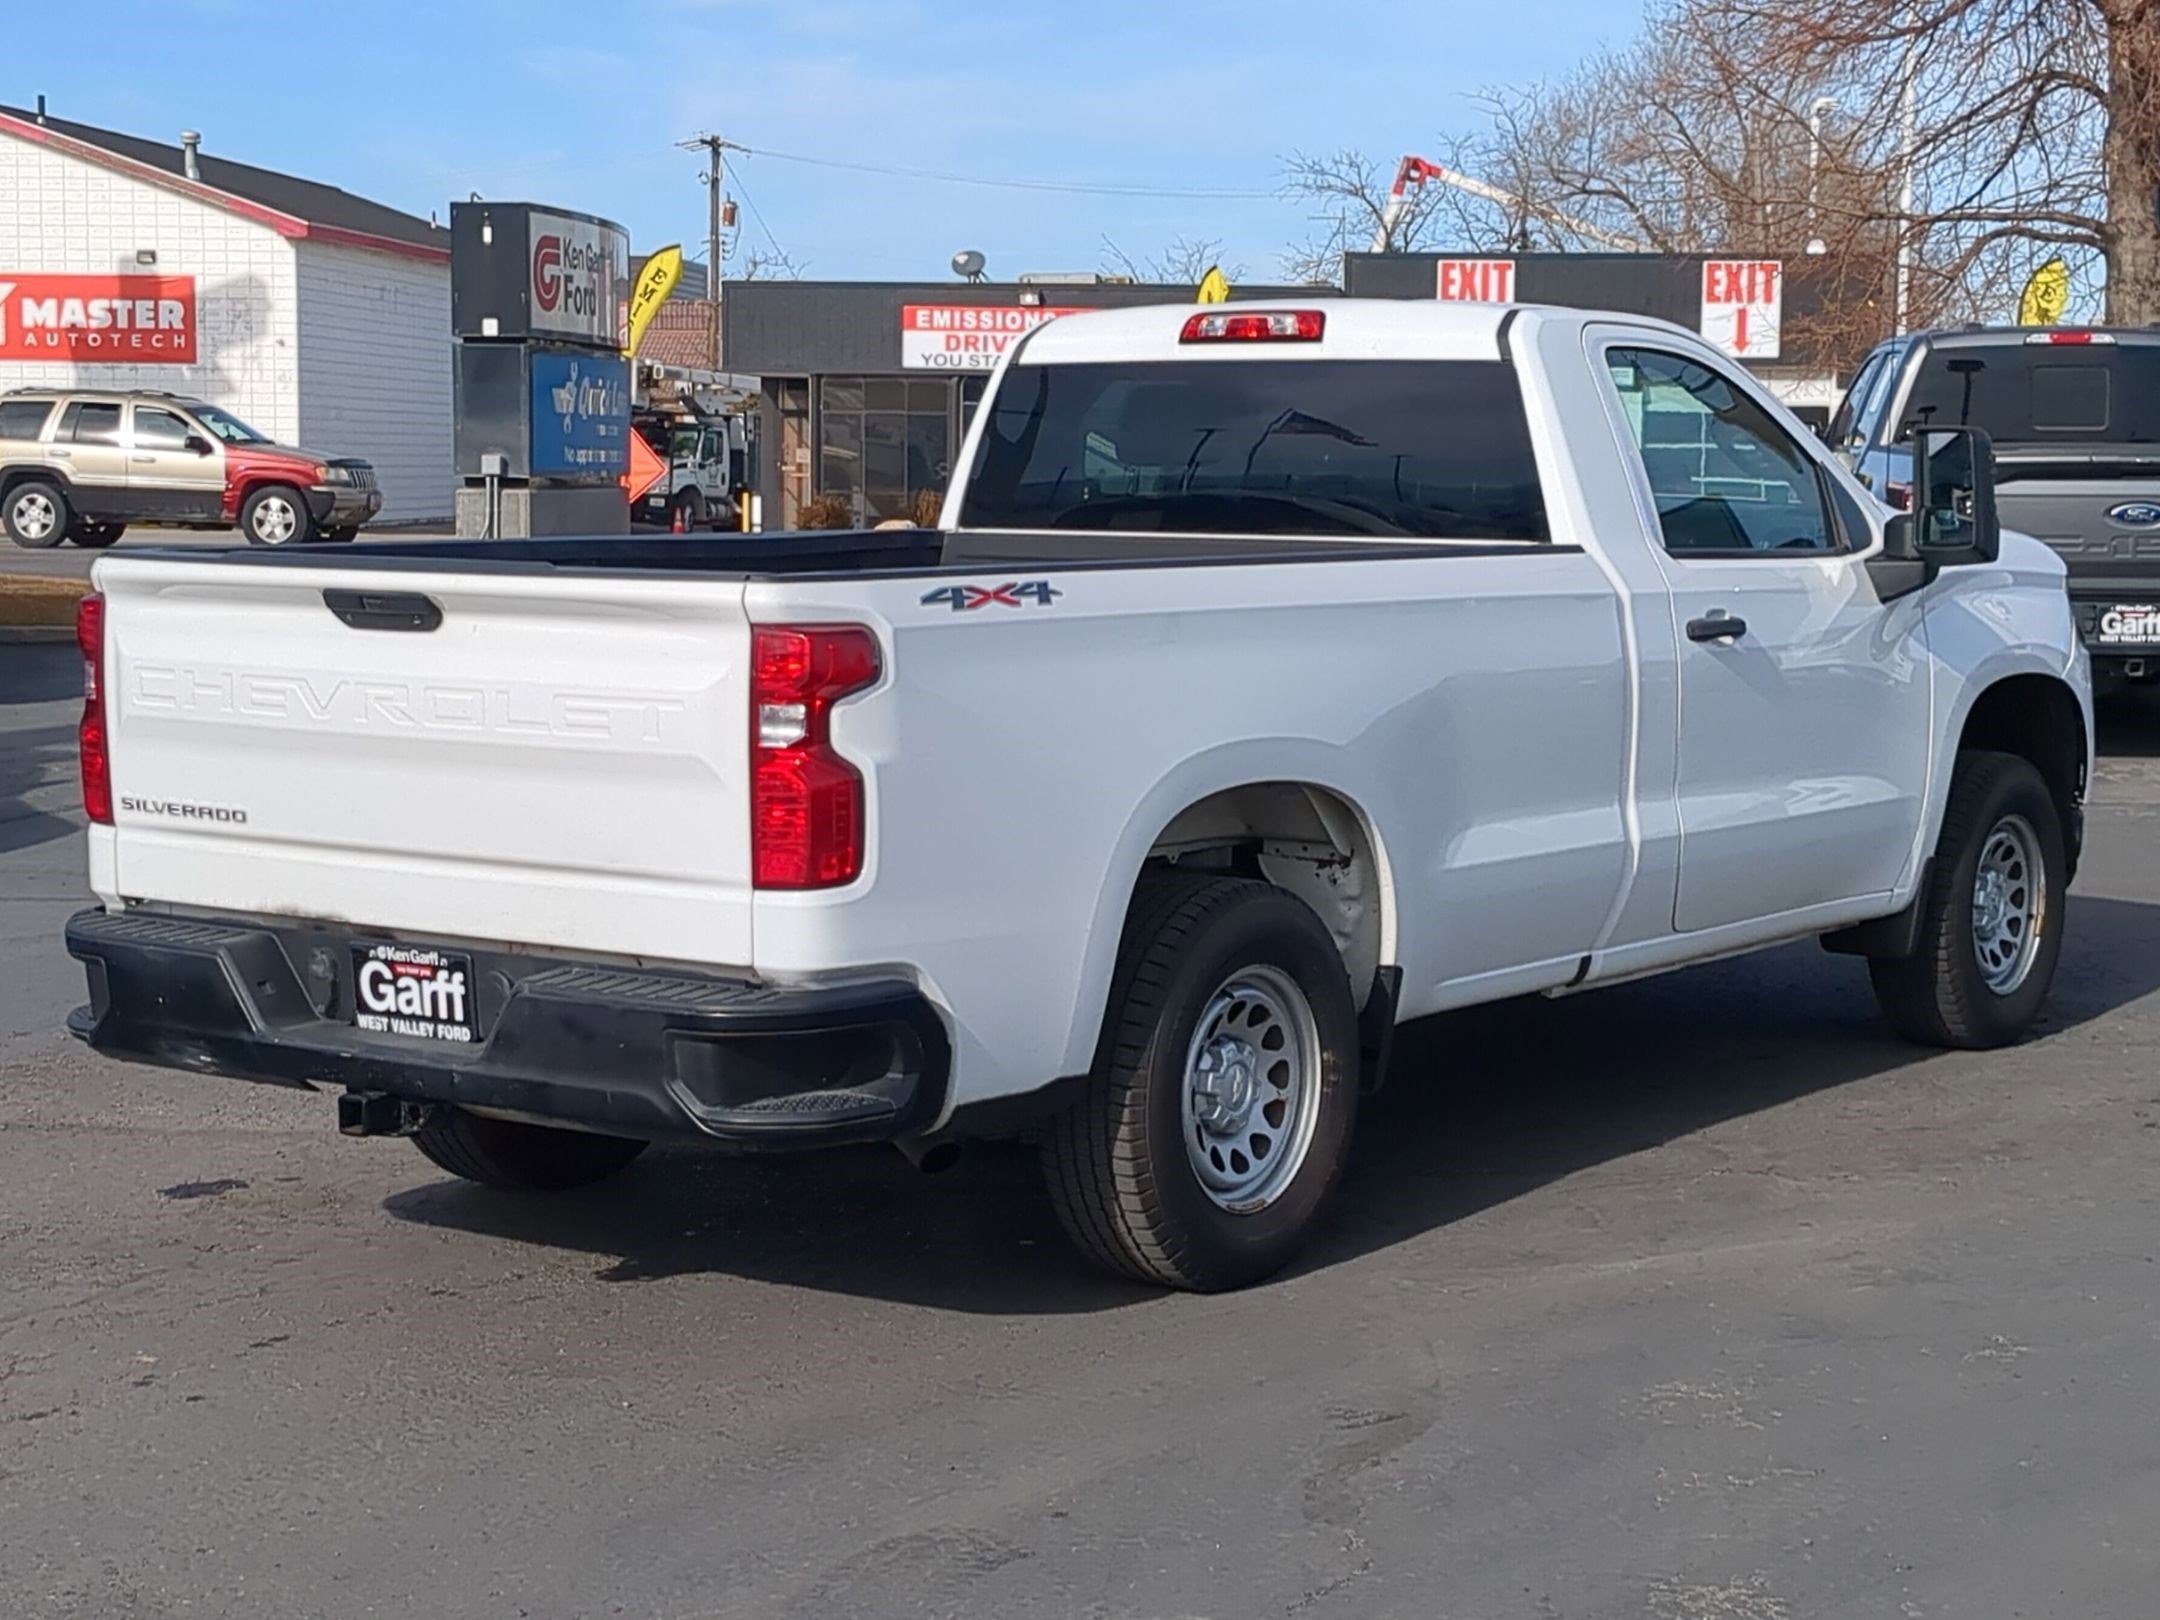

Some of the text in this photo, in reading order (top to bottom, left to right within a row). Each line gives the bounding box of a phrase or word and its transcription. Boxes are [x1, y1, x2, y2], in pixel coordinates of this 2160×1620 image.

[563, 238, 585, 271] Ken
[564, 274, 597, 317] Ford
[1441, 262, 1512, 302] EXIT
[1706, 262, 1779, 304] EXIT
[21, 298, 186, 329] MASTER
[23, 332, 187, 348] AUTOTECH
[945, 334, 1017, 353] DRIV
[921, 353, 962, 367] YOU
[131, 665, 685, 743] CHEVROLET
[121, 797, 248, 825] SILVERADO
[386, 946, 410, 963] Ken
[360, 960, 465, 1022] Garff
[357, 1013, 471, 1042] WEST VALLEY FORD
